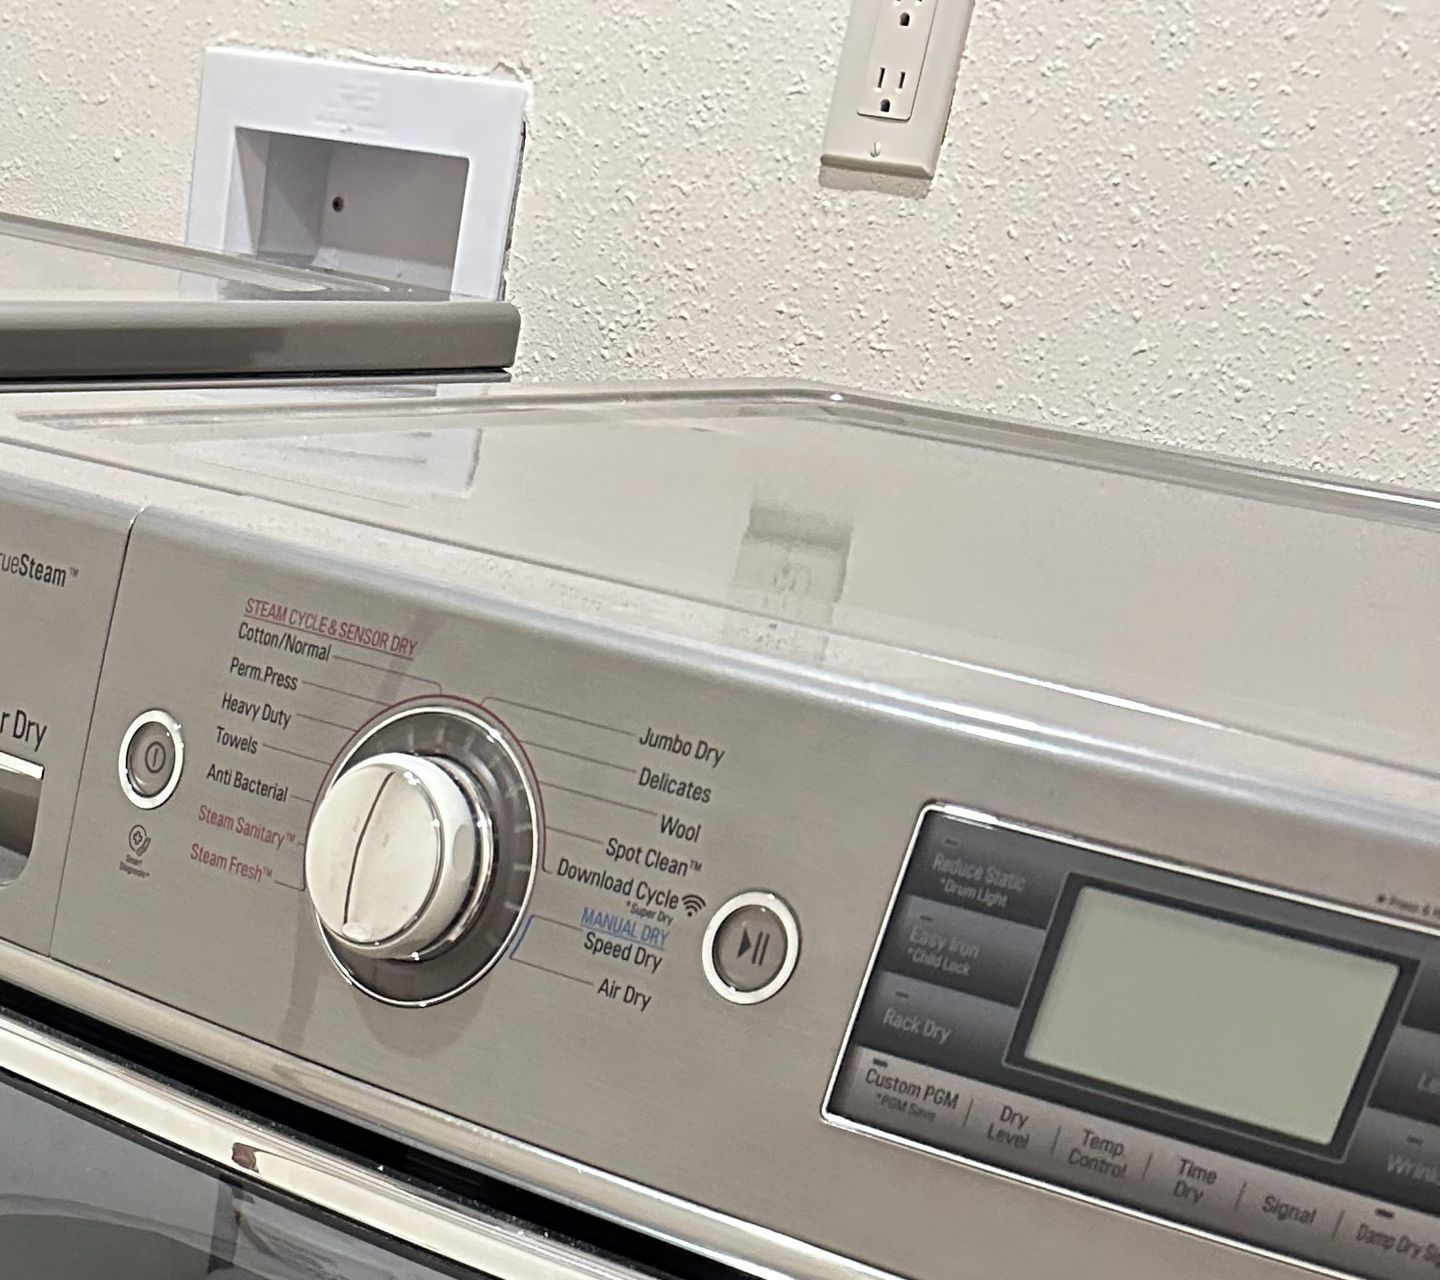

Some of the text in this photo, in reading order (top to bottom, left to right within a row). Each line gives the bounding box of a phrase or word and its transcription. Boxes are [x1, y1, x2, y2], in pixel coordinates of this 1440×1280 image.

[238, 622, 332, 662] Cotton/Normal
[245, 598, 287, 622] STEAM
[289, 609, 326, 633] CYCLE
[338, 622, 389, 648] SENSOR
[391, 635, 419, 656] DRY
[230, 657, 298, 690] Perm.Press
[221, 692, 291, 729] Heavy Duty
[14, 709, 47, 751] Dry
[216, 726, 258, 754] Towels
[639, 727, 725, 768] Jumbo Dry
[206, 763, 288, 803] Anti Bacterial
[638, 767, 712, 804] Delicates
[198, 805, 235, 832] Steam
[659, 814, 701, 843] Wool
[191, 844, 227, 872] Steam
[606, 837, 642, 866] Spot
[557, 857, 679, 909] Download Cycle
[932, 852, 1026, 892] Reduce Static
[976, 886, 1008, 907] Light
[580, 908, 670, 947] MANUAL DRY
[657, 910, 673, 926] Dry
[584, 932, 663, 974] Speed Dry
[910, 925, 947, 952] Easy
[597, 977, 652, 1011] Air Dry
[882, 1008, 952, 1045] Rack Dry
[865, 1068, 959, 1110] Custom PGM
[1000, 1105, 1028, 1129] Dry
[986, 1123, 1030, 1149] Level
[1067, 1149, 1128, 1178] Control
[1178, 1158, 1218, 1185] Time
[1173, 1180, 1204, 1203] Dry
[1262, 1195, 1317, 1224] Signal
[1356, 1223, 1396, 1252] Damp
[1396, 1235, 1424, 1260] Dry
